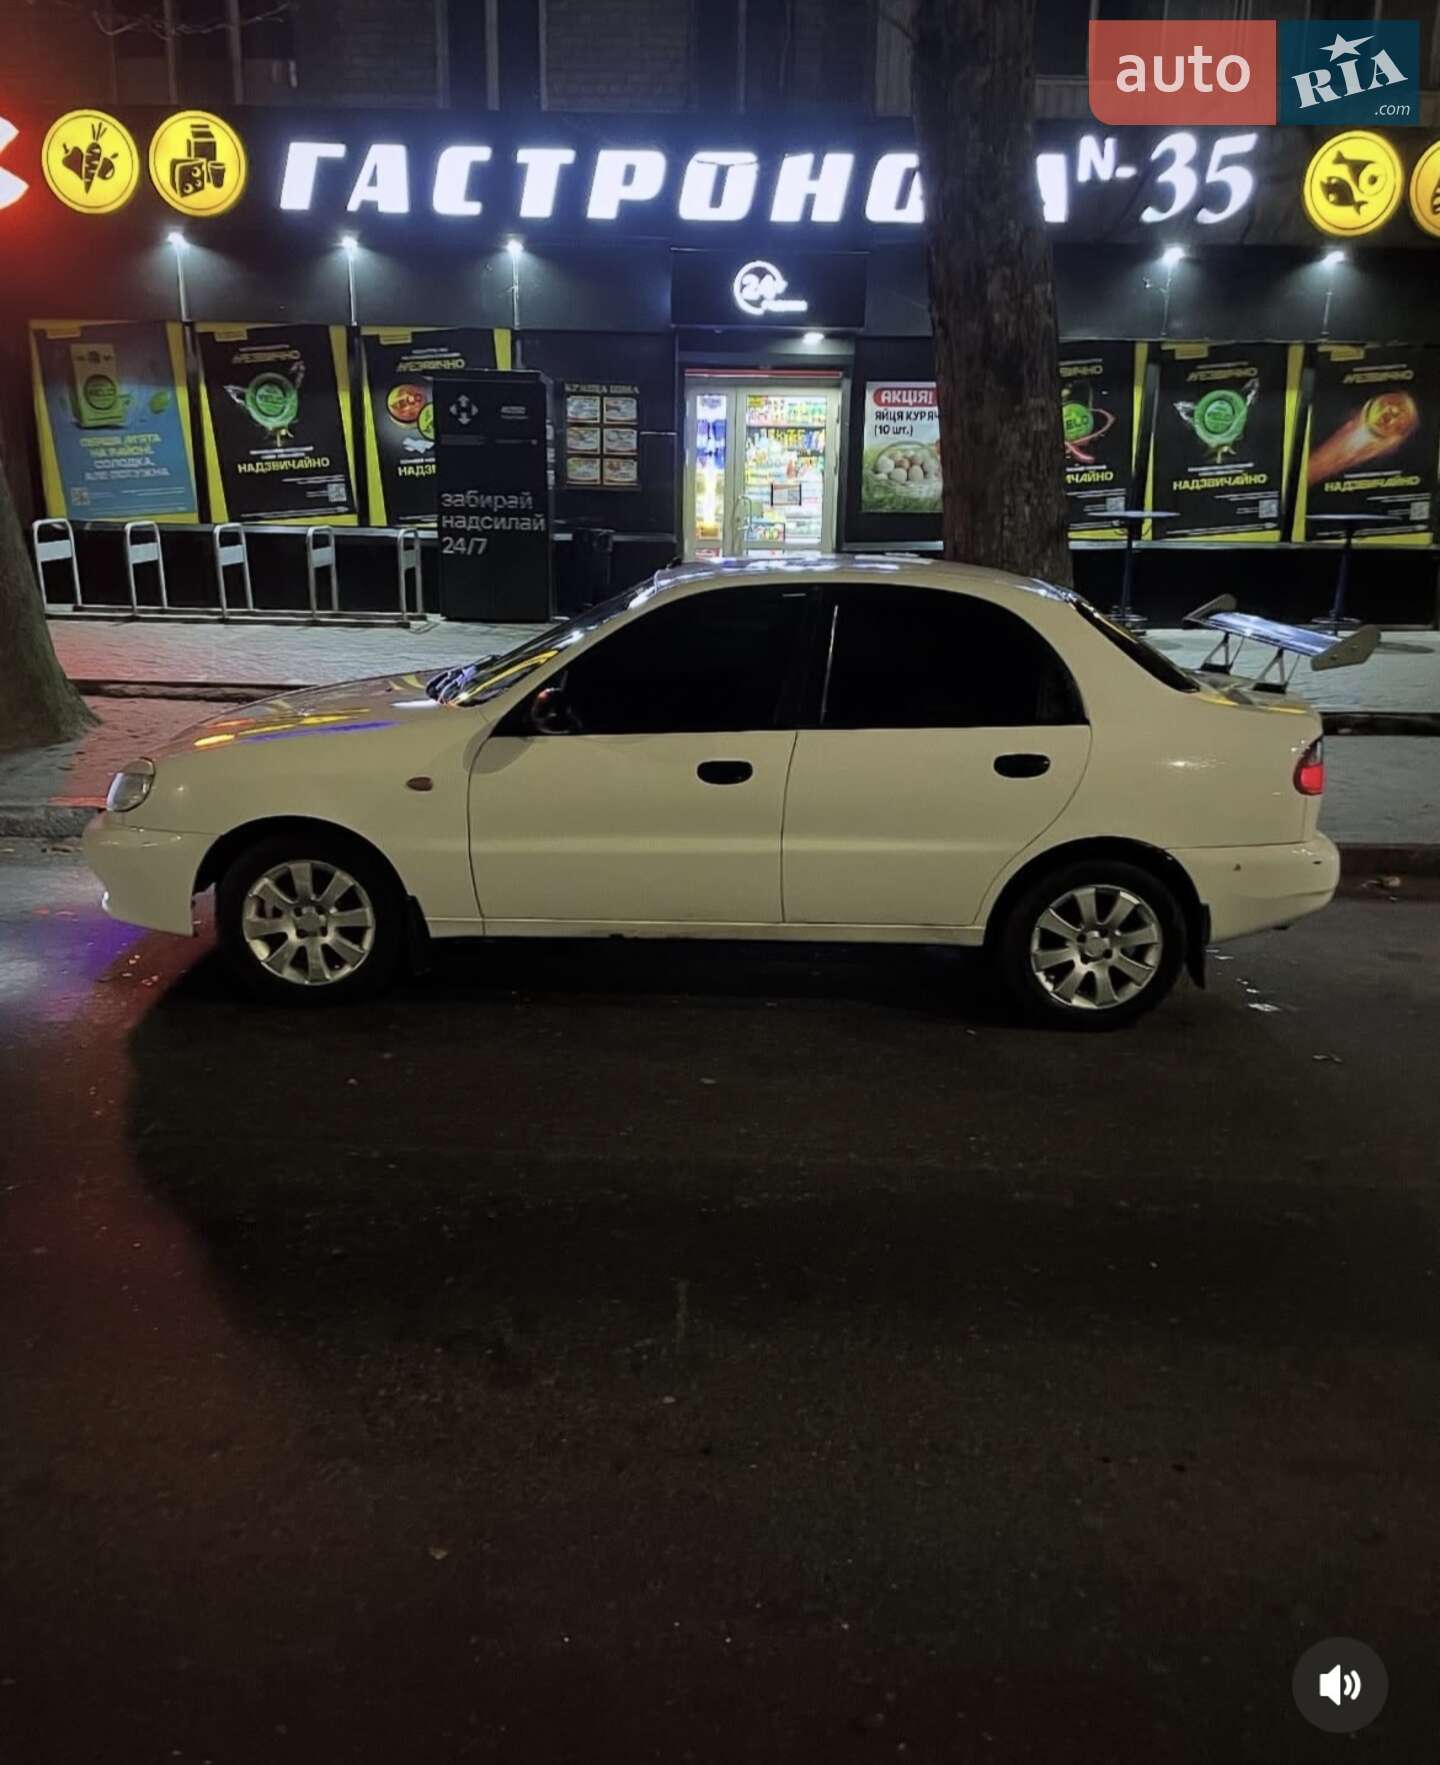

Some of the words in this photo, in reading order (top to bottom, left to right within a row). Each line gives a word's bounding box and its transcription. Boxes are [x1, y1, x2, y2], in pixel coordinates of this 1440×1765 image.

[1140, 131, 1259, 224] 35
[880, 389, 933, 406] АКЦІЯ!
[874, 408, 904, 423] ЯЙЦЯ
[237, 456, 330, 474] НАДЗВИЧАЙНО
[1172, 471, 1268, 491] НАДЗВИЧАЙНО
[441, 490, 534, 510] забирай
[441, 513, 546, 532] надсилай
[441, 536, 488, 556] 24/7
